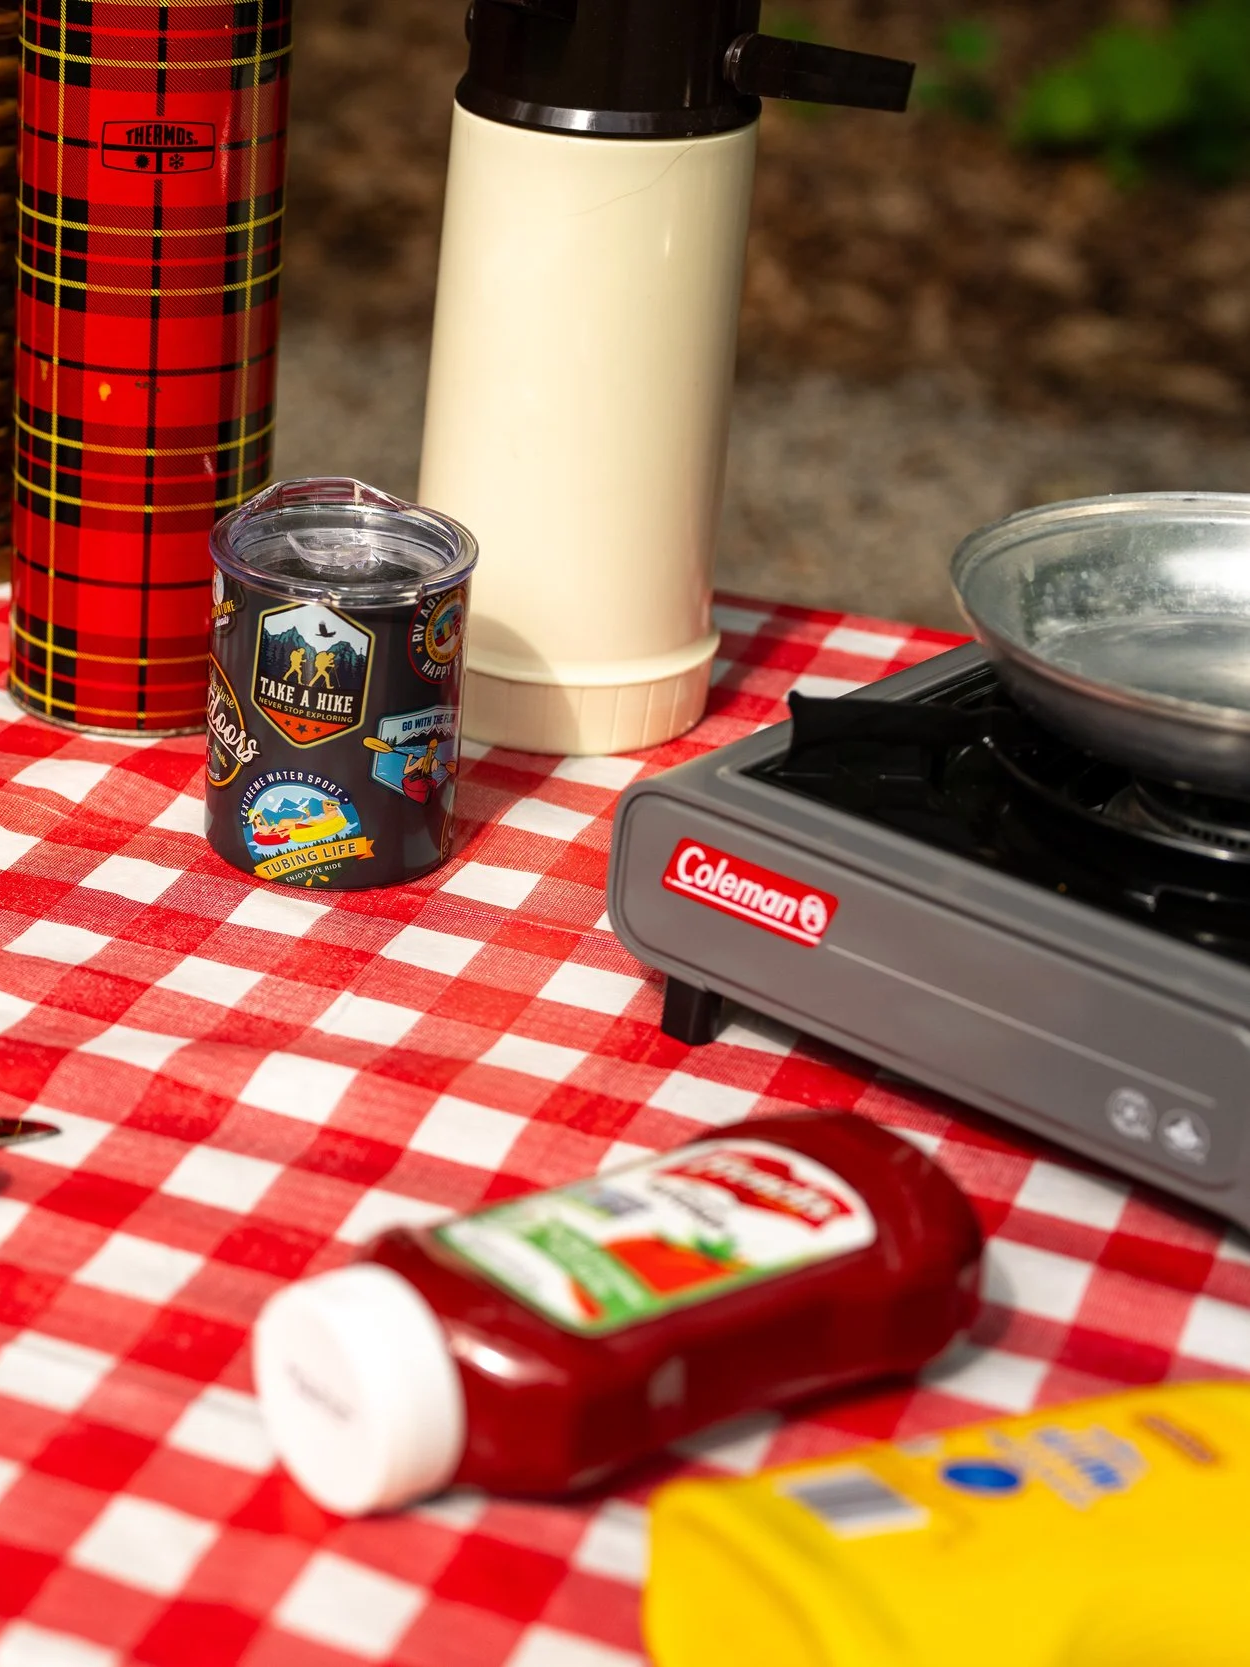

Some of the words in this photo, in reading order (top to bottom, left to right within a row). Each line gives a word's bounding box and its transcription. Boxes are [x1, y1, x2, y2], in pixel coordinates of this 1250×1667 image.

[412, 624, 425, 642] RV
[421, 659, 452, 679] HAPPY
[260, 676, 295, 704] TAKE
[299, 689, 310, 708] A
[316, 692, 354, 714] HIKE
[258, 696, 282, 710] NEVER
[283, 704, 304, 716] STOP
[306, 711, 354, 723] EXPLORING
[402, 721, 413, 731] GO
[415, 716, 432, 729] WITH
[434, 714, 444, 725] THE
[240, 777, 266, 817] EXTREME
[266, 771, 303, 783] WATER
[307, 774, 343, 796] SPORT
[263, 850, 318, 876] TUBING
[323, 842, 356, 858] LIFE
[285, 870, 307, 883] ENJOY
[308, 866, 323, 875] THE
[324, 862, 342, 871] RIDE
[676, 845, 799, 924] Coleman
